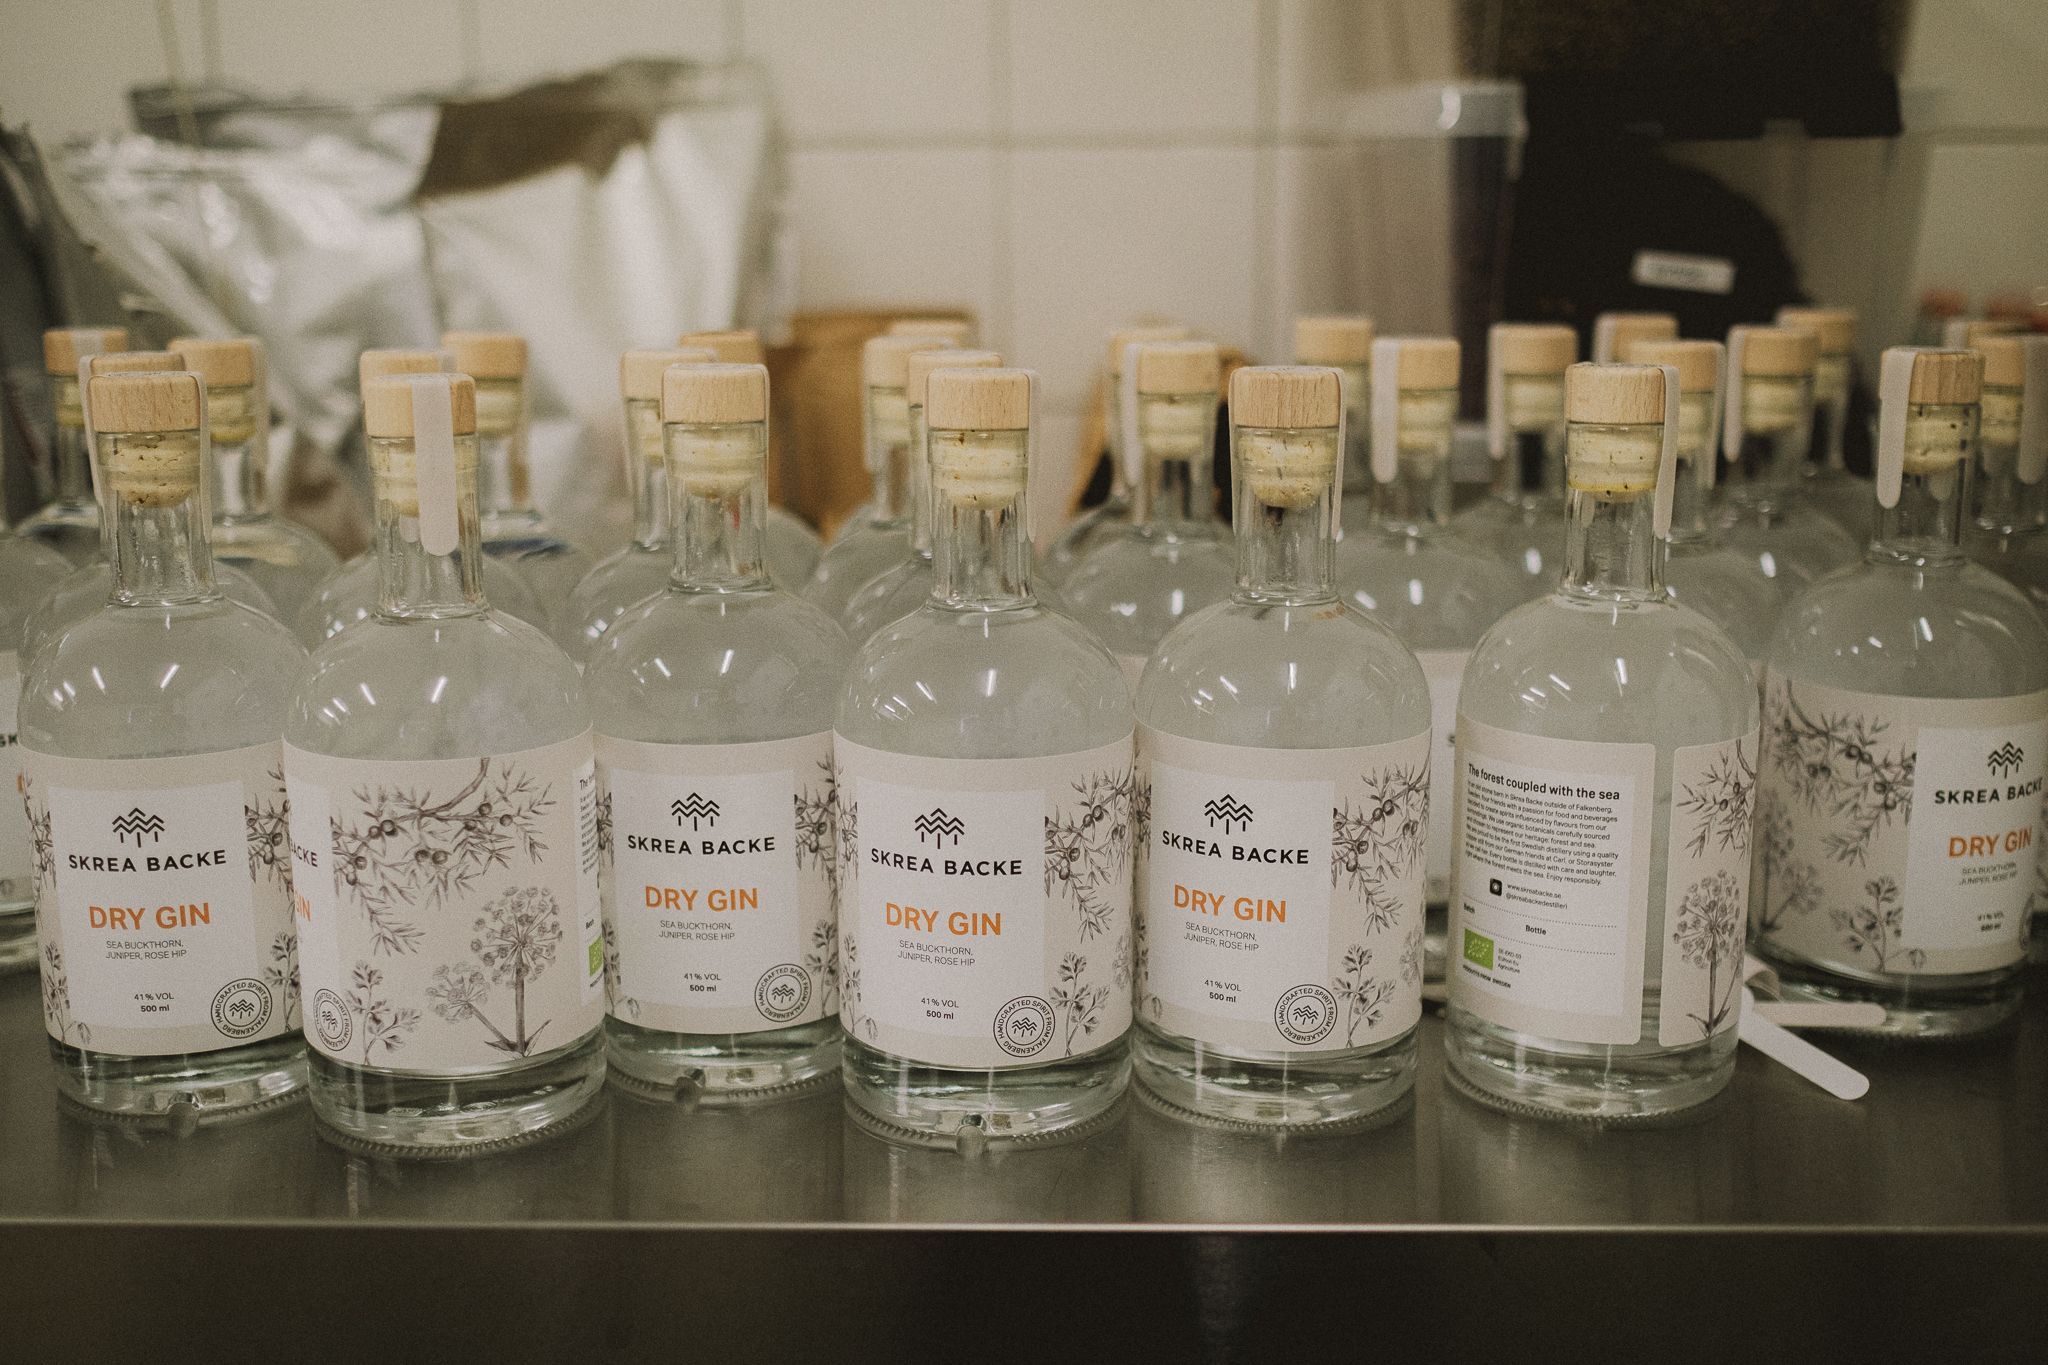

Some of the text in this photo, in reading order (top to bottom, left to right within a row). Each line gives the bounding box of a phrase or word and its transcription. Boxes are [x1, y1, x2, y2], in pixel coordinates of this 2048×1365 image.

[1469, 763, 1480, 778] The
[1480, 768, 1504, 786] forest
[1506, 778, 1547, 794] coupled
[1549, 785, 1573, 797] with
[1576, 787, 1596, 799] the
[1598, 791, 1620, 800] sea
[1526, 797, 1543, 806] Backe
[1544, 801, 1567, 810] outside
[1934, 789, 2000, 804] SKREA
[1515, 814, 1544, 824] influenced
[1545, 819, 1552, 827] by
[1554, 820, 1578, 829] flavours
[1522, 806, 1544, 816] passion
[1584, 814, 1618, 823] beverages
[1525, 824, 1555, 835] botanicals
[1556, 830, 1582, 839] carefully
[628, 834, 776, 855] SKREA BACKE
[1162, 830, 1309, 864] SKREA BACKE
[1551, 838, 1569, 846] forest
[1948, 824, 2033, 858] DRY GIN
[290, 840, 318, 868] ACKE
[1521, 842, 1545, 851] Swedish
[1546, 846, 1572, 856] distillery
[1597, 852, 1619, 860] quality
[69, 849, 227, 872] SKREA BACKE
[871, 848, 1022, 876] SKREA BACKE
[1576, 859, 1614, 868] Storasyster
[1546, 873, 1563, 882] Enjoy
[1547, 864, 1560, 872] with
[1589, 869, 1617, 877] laughter,
[645, 885, 758, 912] DRY GIN
[1174, 884, 1286, 924] DRY GIN
[89, 902, 211, 930] DRY GIN
[886, 902, 1001, 936] DRY GIN
[660, 920, 676, 929] SEA
[1185, 921, 1200, 932] SEA
[1526, 924, 1547, 935] Bottle
[696, 932, 719, 941] ROSE
[722, 932, 735, 940] HIP
[106, 940, 123, 949] SEA
[899, 940, 915, 950] SEA
[1218, 938, 1243, 949] ROSE
[1244, 942, 1259, 952] HIP
[144, 950, 172, 960] ROSE
[174, 949, 188, 958] HIP
[934, 956, 959, 966] ROSE
[961, 958, 976, 967] HIP
[704, 972, 722, 981] VOL
[248, 982, 266, 996] SPIRIT
[689, 984, 717, 992] 500 ml
[758, 967, 788, 1006] HANDCRAFTED
[1224, 982, 1242, 992] VOL
[156, 992, 174, 1000] VOL
[215, 982, 247, 1024] HANDCRAFTED
[1209, 992, 1236, 1004] 500 ml
[140, 1004, 170, 1013] 500 ml
[941, 999, 960, 1009] VOL
[926, 1010, 954, 1020] 500 ml
[1278, 988, 1334, 1042] HANDCRAFTED SPIRIT FROM FALKENBERG
[222, 1016, 265, 1036] FALKENBERG
[998, 1000, 1052, 1054] HANDCRAFTED SPIRIT FROM FALKENBERG
